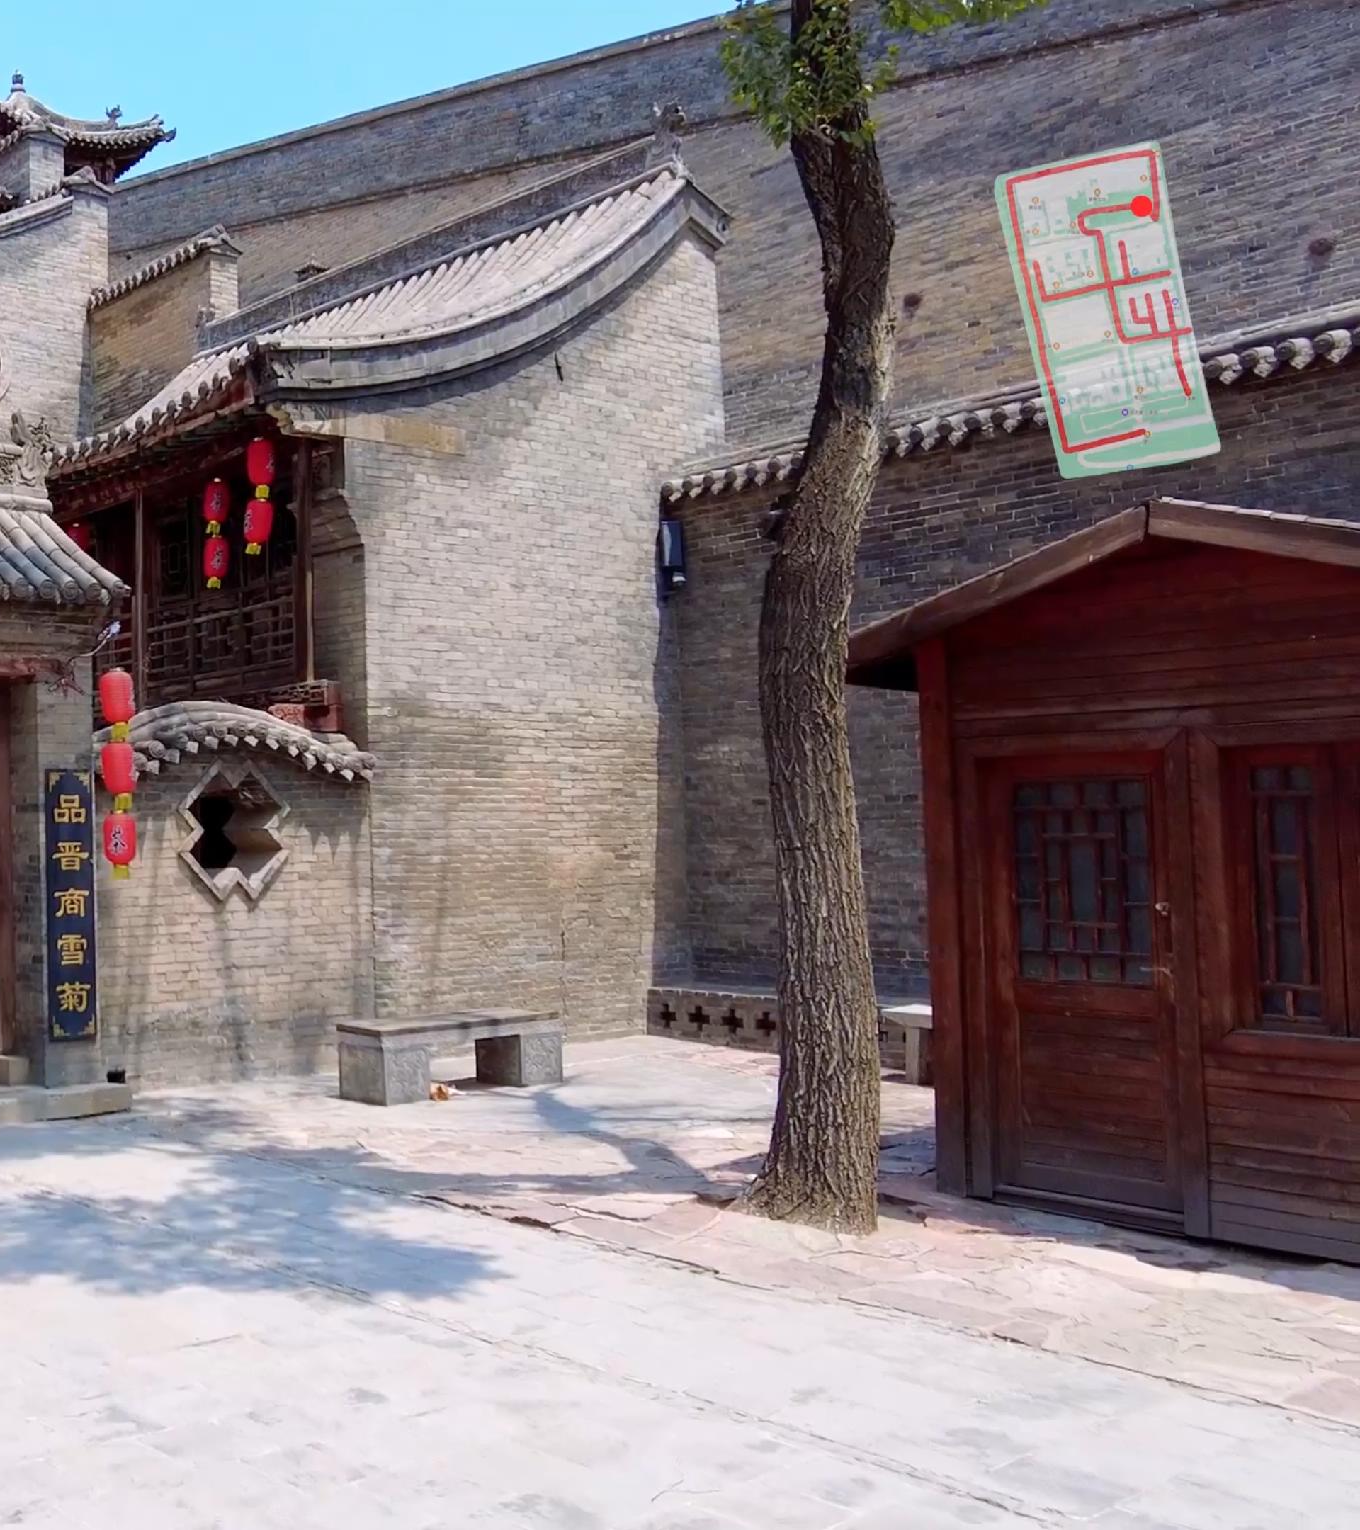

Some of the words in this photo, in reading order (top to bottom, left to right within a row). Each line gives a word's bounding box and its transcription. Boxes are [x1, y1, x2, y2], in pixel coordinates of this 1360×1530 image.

[52, 794, 90, 1013] 品晋商雪菊
